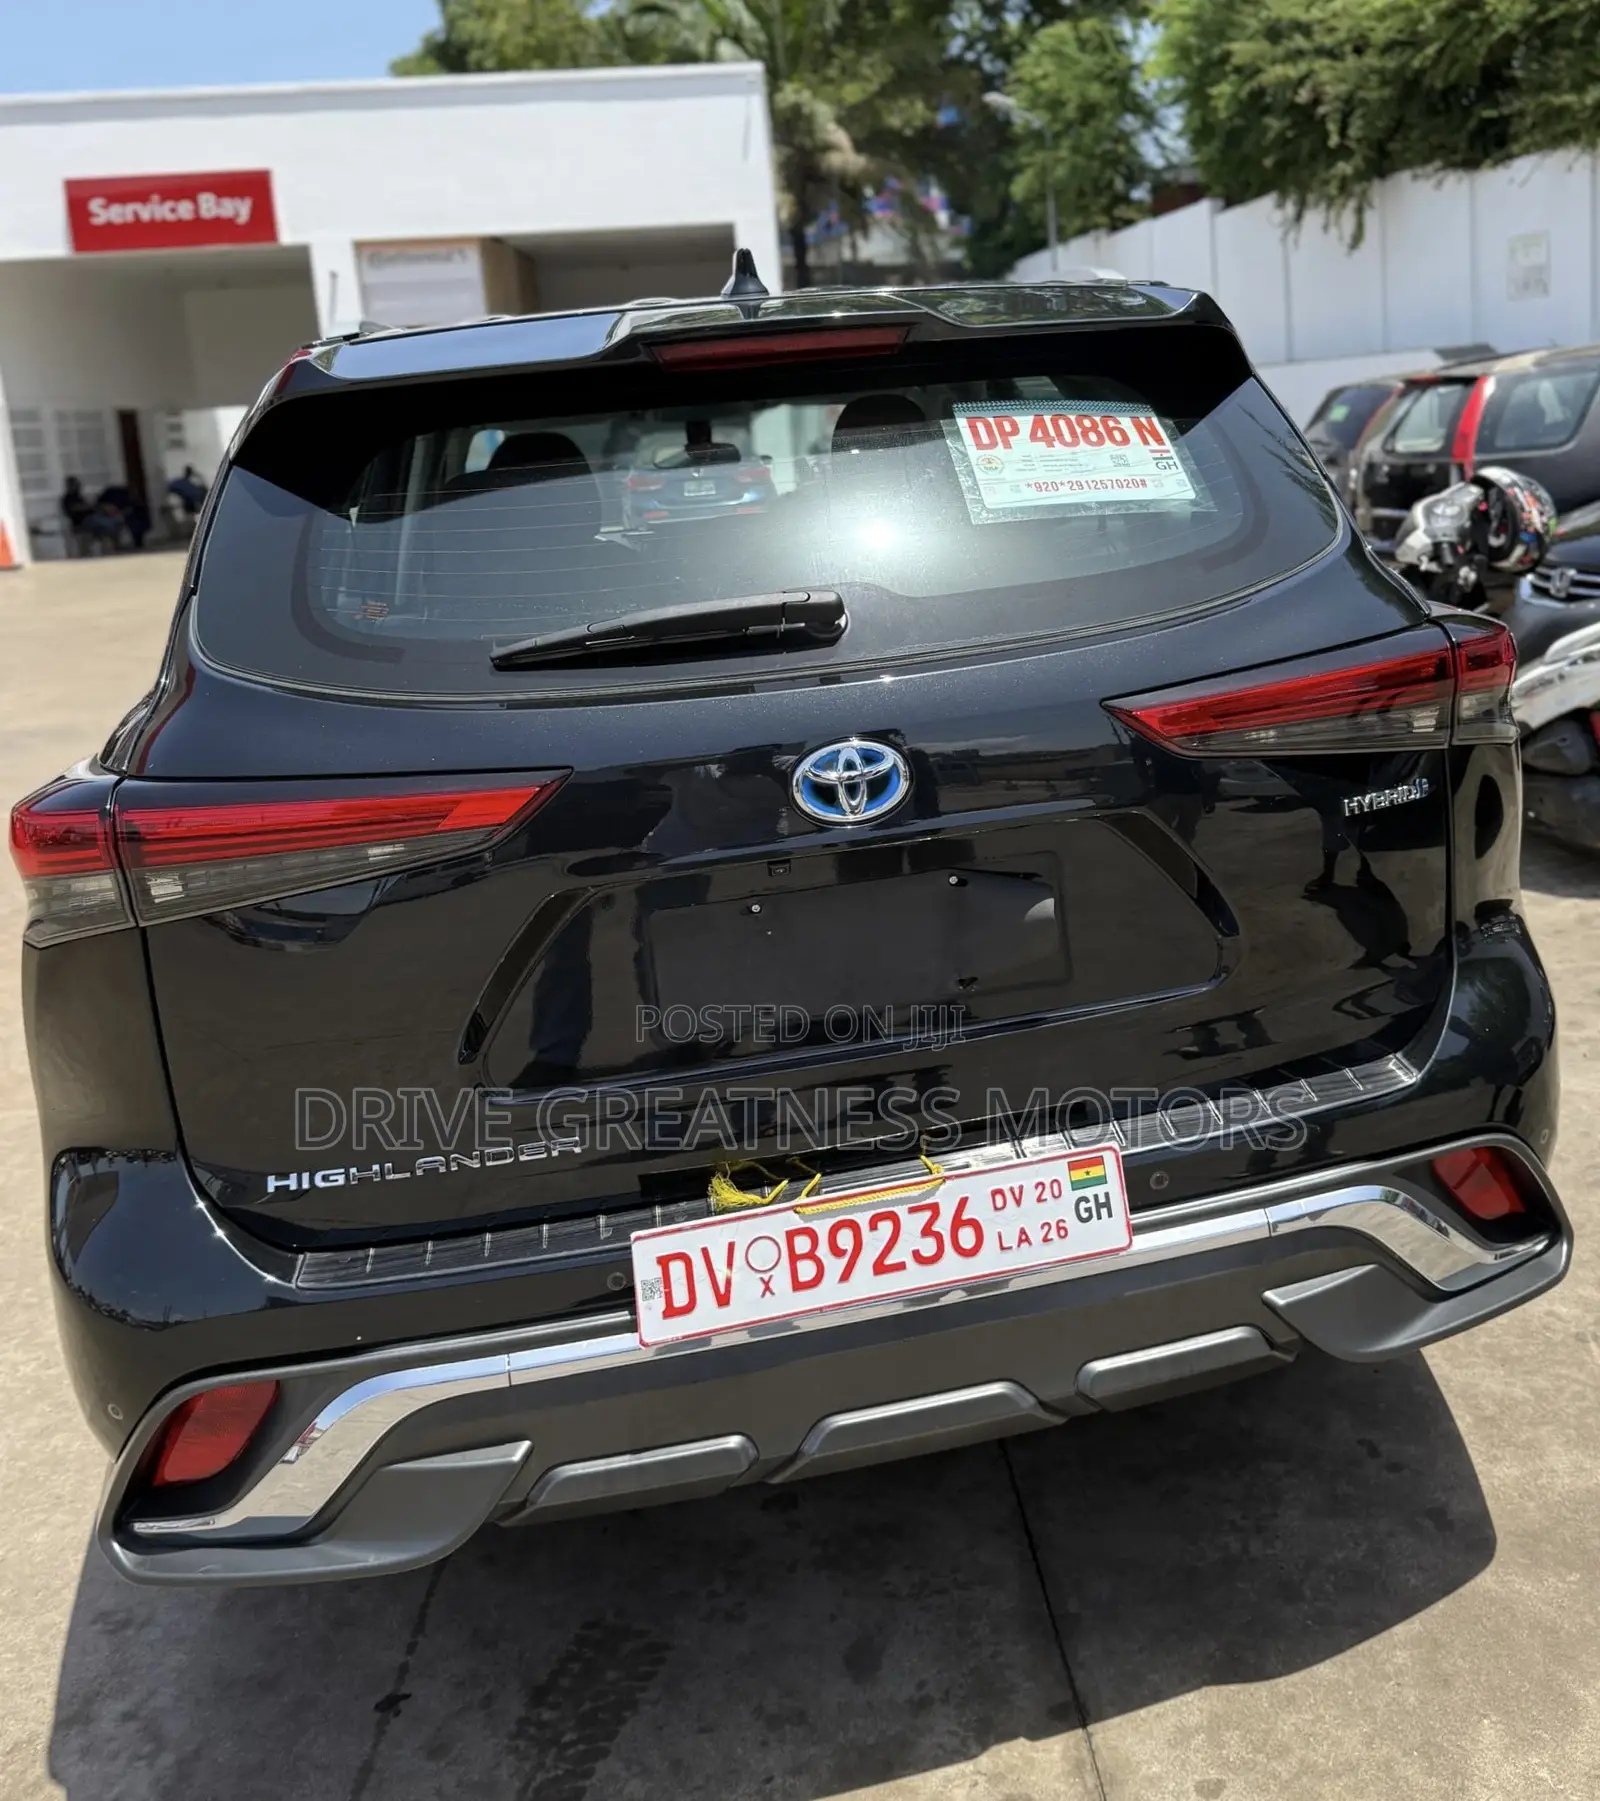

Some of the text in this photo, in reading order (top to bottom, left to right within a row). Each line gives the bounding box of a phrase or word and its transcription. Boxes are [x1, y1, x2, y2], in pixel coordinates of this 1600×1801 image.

[88, 191, 253, 226] Service Bay
[966, 413, 1165, 450] DP 4086 N
[1155, 461, 1179, 472] GH
[1343, 785, 1417, 816] HYBRID
[266, 1136, 582, 1194] HIGHLANDER
[990, 1178, 1063, 1212] DV 20
[1074, 1190, 1113, 1224] GH
[997, 1218, 1069, 1251] LA 26
[656, 1241, 735, 1320] DV
[785, 1196, 985, 1293] B9236
